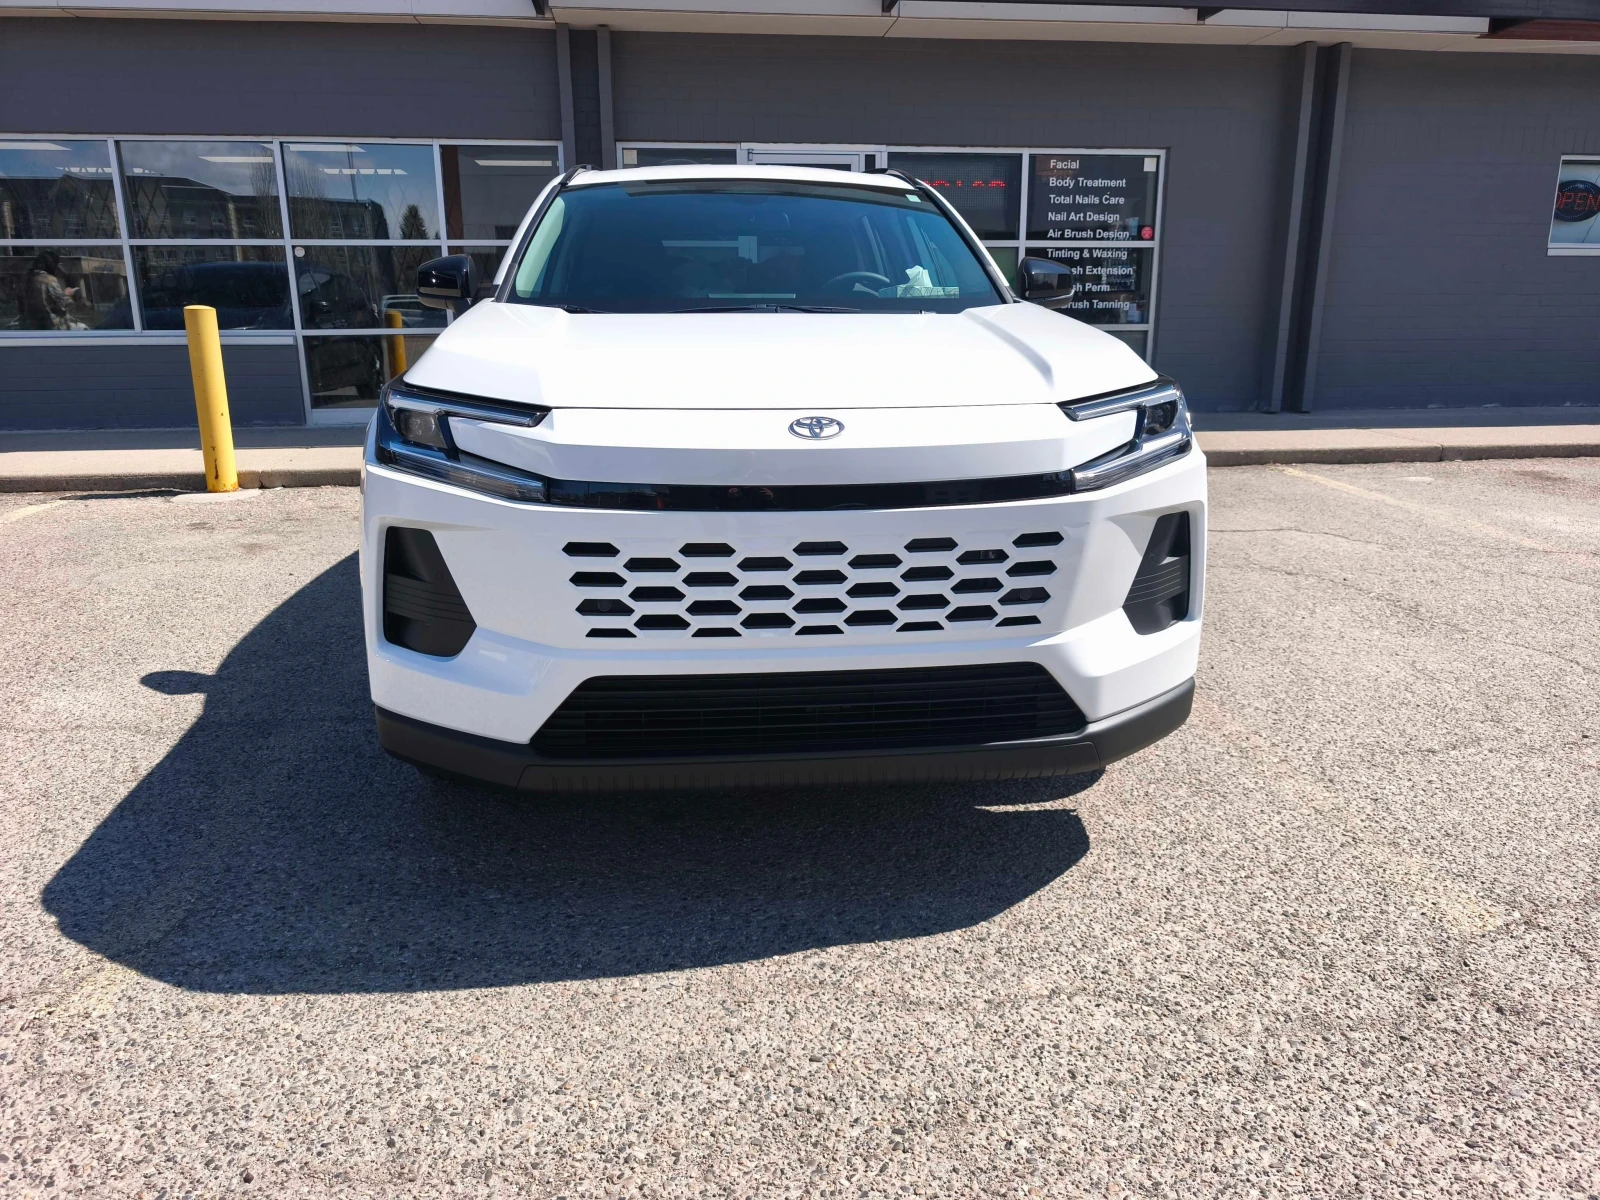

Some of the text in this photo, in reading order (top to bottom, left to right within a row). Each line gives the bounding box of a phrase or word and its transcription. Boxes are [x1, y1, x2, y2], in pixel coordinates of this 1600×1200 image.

[1050, 159, 1080, 170] Facial
[1049, 177, 1127, 189] Body Treatment
[1049, 194, 1125, 205] Total Nails Care
[1048, 211, 1120, 223] Nail Art Design
[1047, 228, 1063, 239] Air
[1064, 228, 1094, 239] Brush
[1096, 228, 1130, 240] Design
[1046, 248, 1128, 260] Tinting & Waxing
[1085, 265, 1133, 275] Extension
[1085, 282, 1110, 292] Perm
[1061, 299, 1130, 311] rush Tanning
